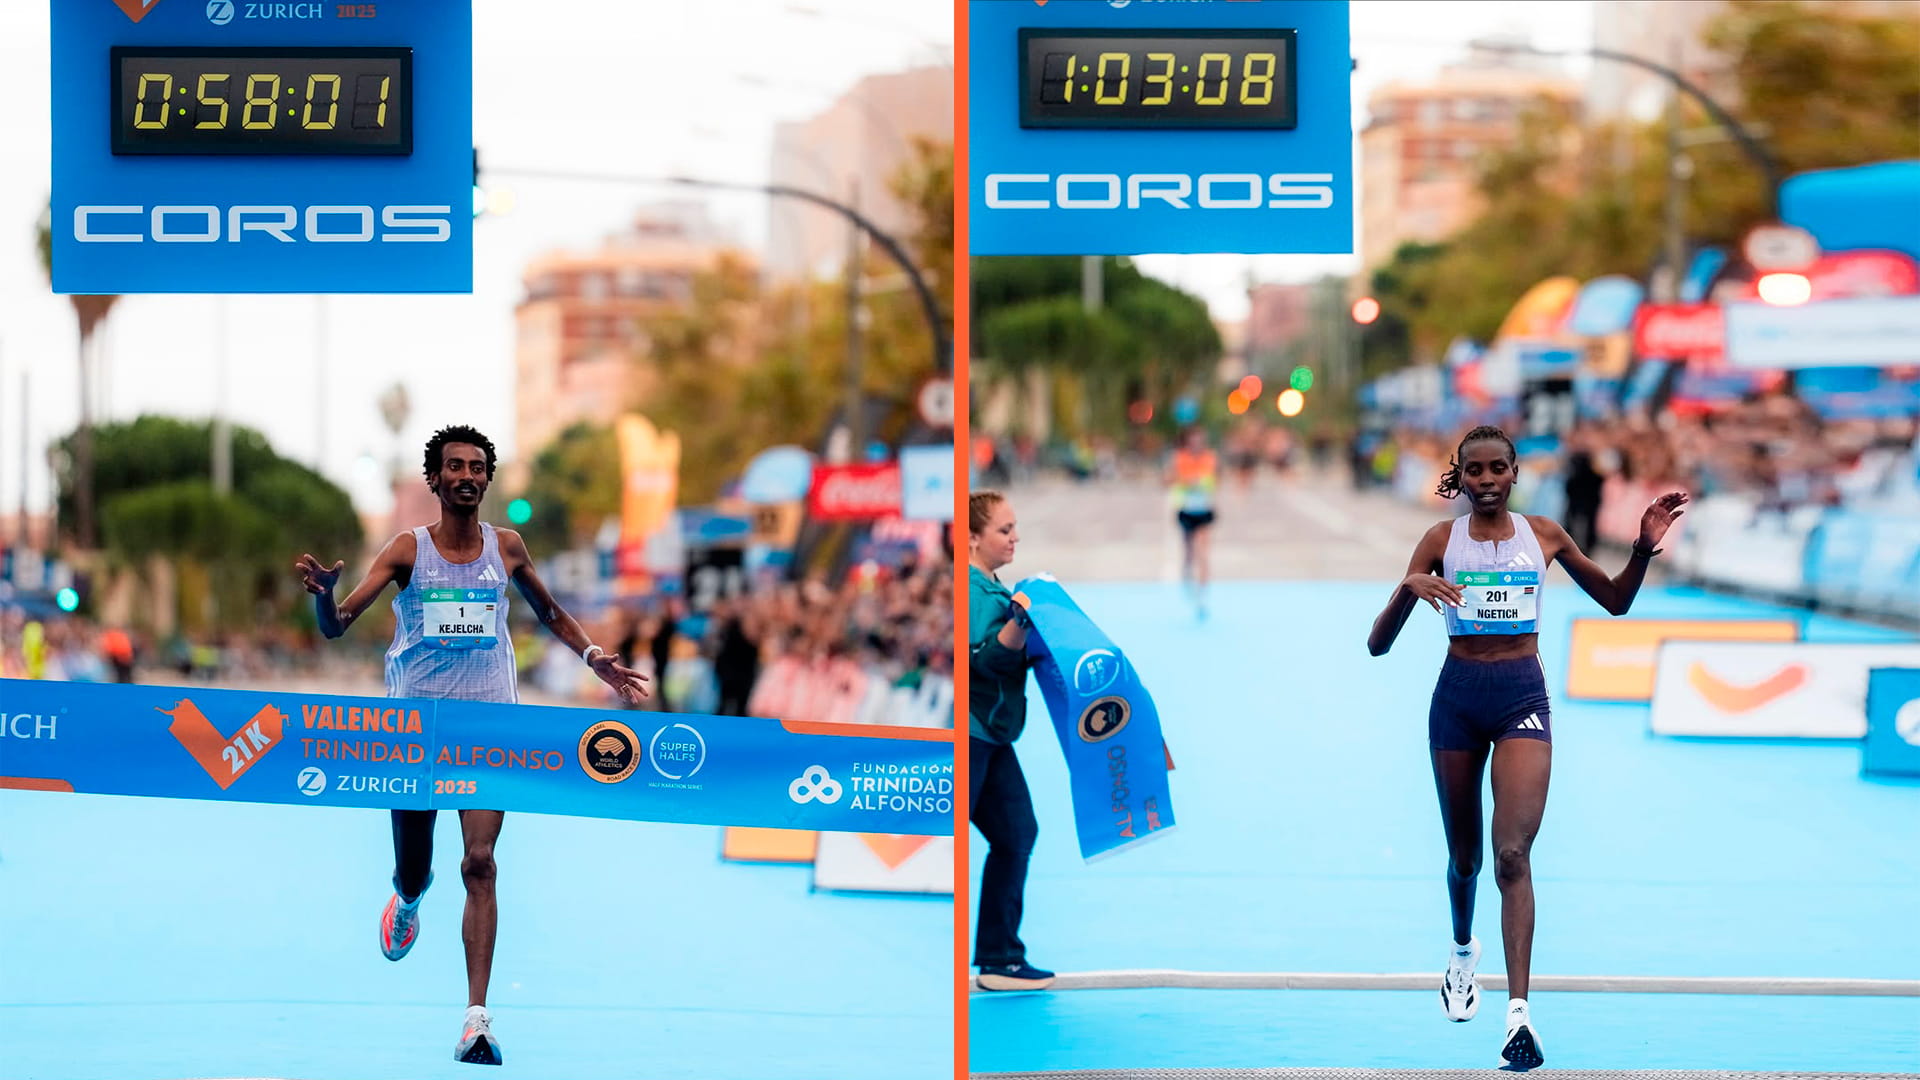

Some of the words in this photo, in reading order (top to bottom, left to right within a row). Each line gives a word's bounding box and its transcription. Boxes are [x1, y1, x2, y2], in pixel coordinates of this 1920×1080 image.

[244, 3, 323, 19] ZURICH
[1064, 52, 1277, 106] 1:03:08
[133, 73, 391, 130] 0:58:01
[985, 173, 1334, 209] COROS
[73, 205, 452, 243] COROS
[1486, 590, 1508, 603] 201
[458, 606, 465, 618] 1
[1477, 608, 1518, 619] NGETICH
[439, 623, 484, 635] KEJELCHA
[301, 704, 423, 735] VALENCIA
[221, 719, 272, 776] 21K
[300, 737, 425, 765] TRINIDAD
[435, 744, 565, 772] ALFONSO
[660, 741, 697, 752] SUPER
[659, 752, 696, 762] HALFS
[853, 762, 953, 775] FUNDACIÓN
[335, 775, 418, 795] ZURICH
[434, 779, 478, 796] 2025
[850, 776, 953, 795] TRINIDAD
[1107, 745, 1137, 838] ALFONSO
[850, 794, 952, 814] ALFONSO
